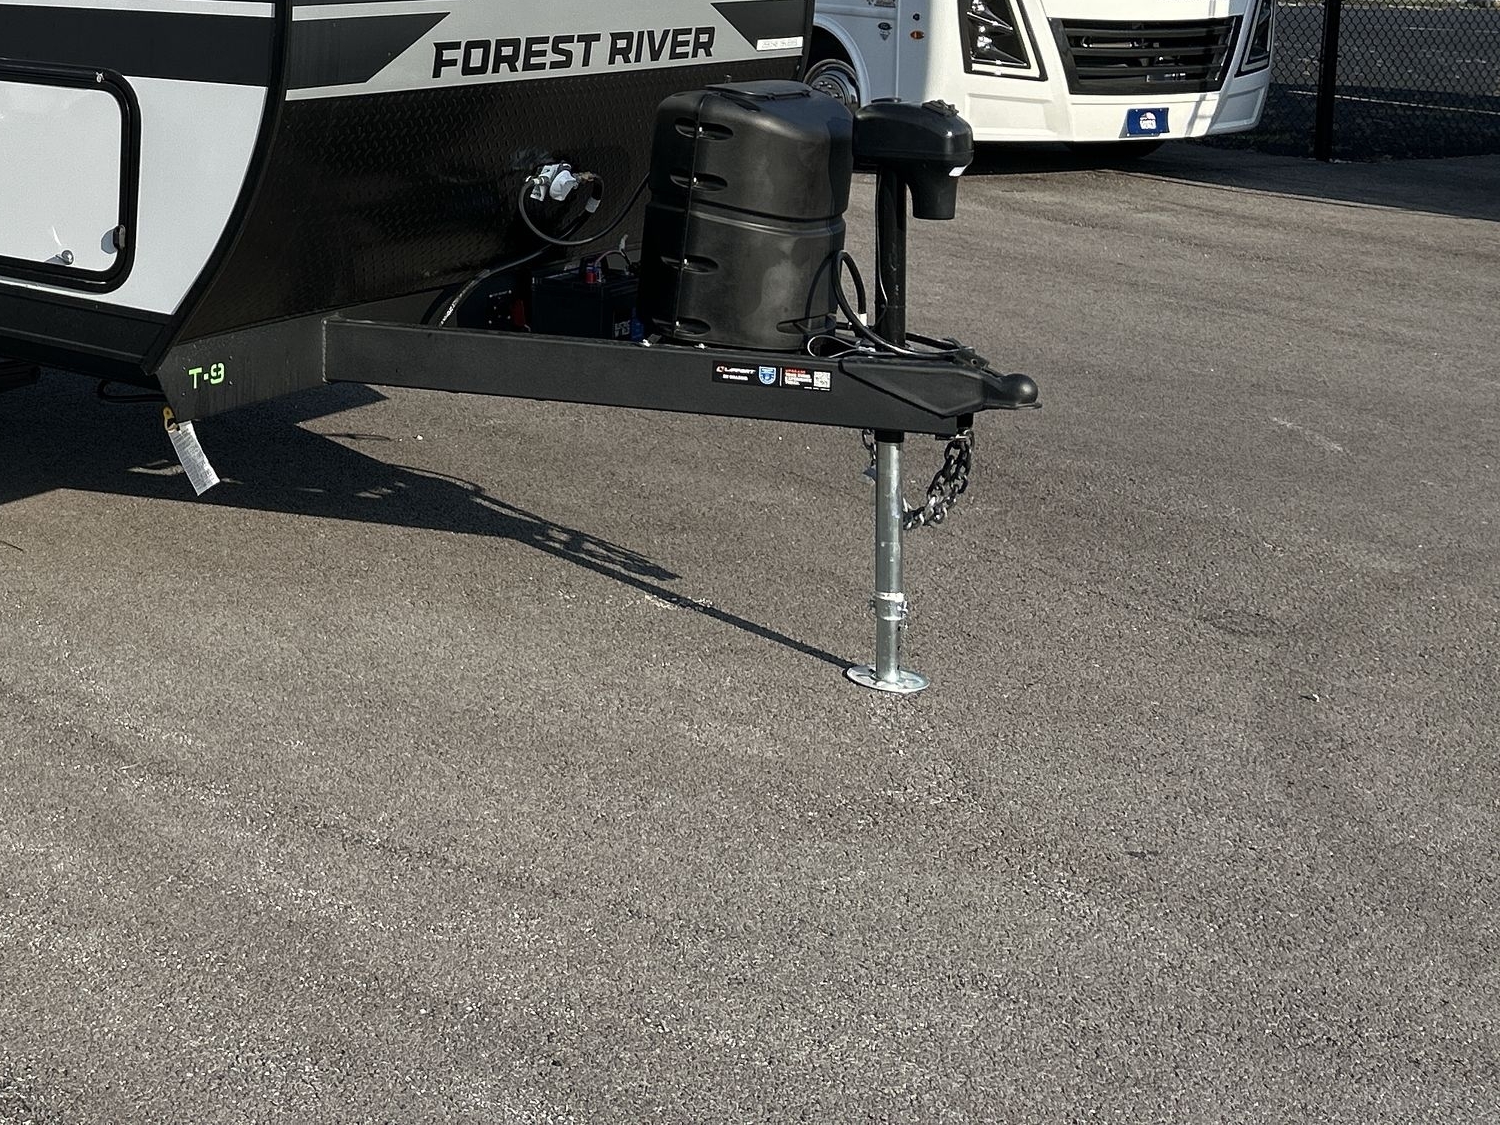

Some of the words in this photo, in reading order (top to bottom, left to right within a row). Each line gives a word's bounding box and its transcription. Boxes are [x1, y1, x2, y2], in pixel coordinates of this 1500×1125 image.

[432, 33, 601, 79] FOREST
[608, 26, 716, 65] RIVER
[188, 361, 226, 389] T-9
